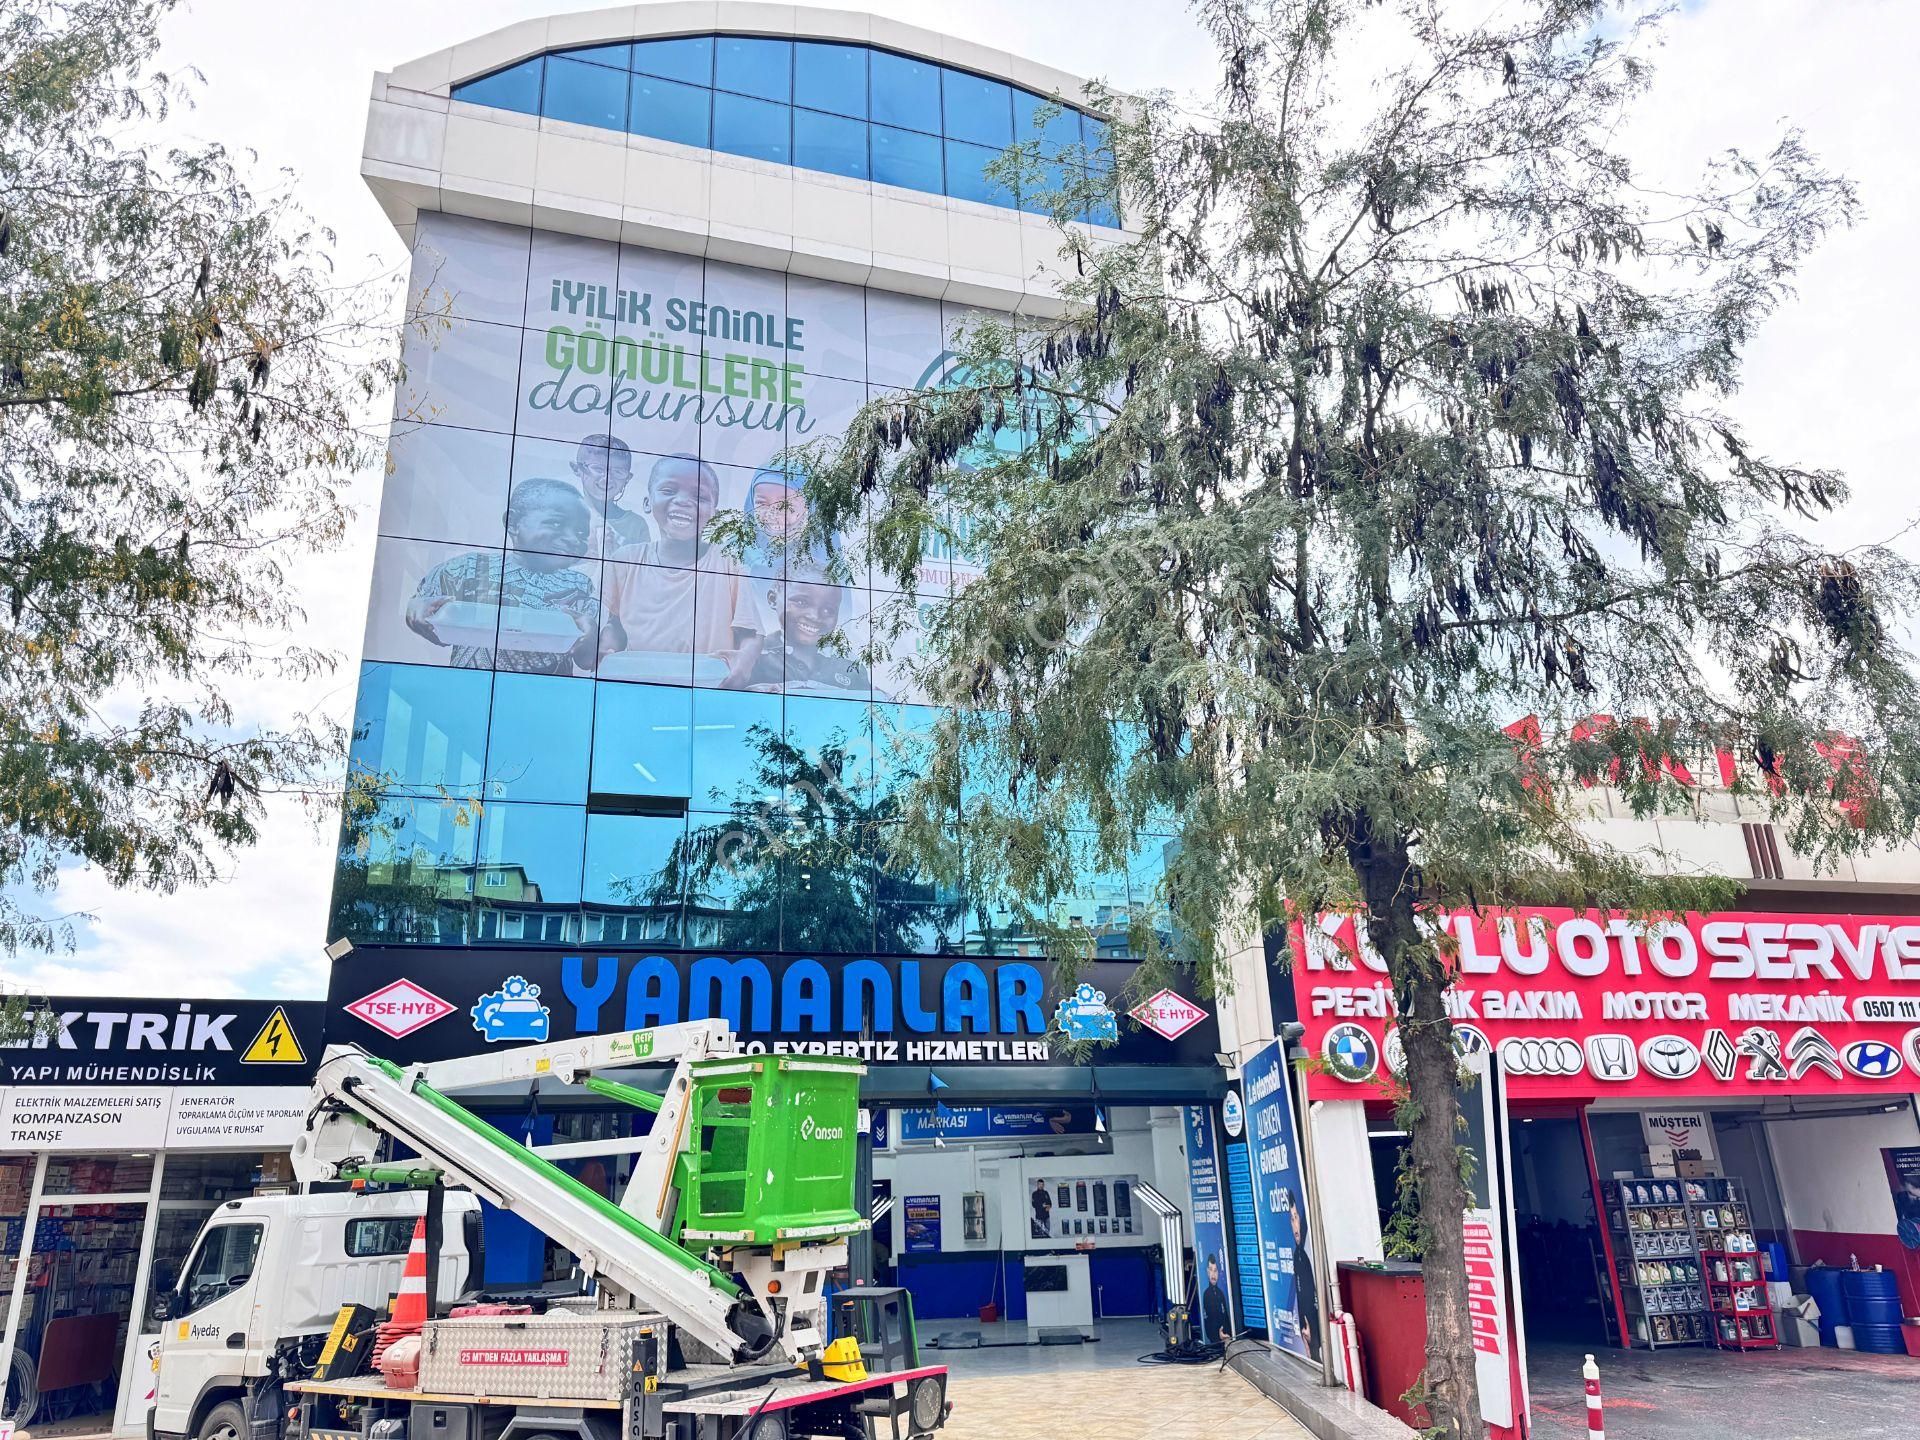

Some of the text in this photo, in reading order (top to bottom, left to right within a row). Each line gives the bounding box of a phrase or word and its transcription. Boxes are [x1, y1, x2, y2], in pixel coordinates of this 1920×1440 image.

[550, 279, 805, 351] İYİLİK SENİNLE
[545, 321, 805, 406] GÖNÜLLERE
[528, 364, 817, 434] dokunsun
[1556, 917, 1698, 978] OTO
[561, 956, 1047, 1034] YAMANLAR
[366, 1002, 436, 1015] TSE-HYB
[1482, 990, 1583, 1020] BAKIM
[1602, 991, 1710, 1021] MOTOR
[1728, 989, 1852, 1022] MEKANİK
[1863, 1000, 1895, 1018] 0507
[639, 1043, 649, 1055] 18
[11, 1063, 217, 1081] YAPI MÜHENDİSLİK
[15, 1095, 162, 1109] ELEKTRİK MALZEMELERİ SATIŞ
[180, 1095, 235, 1106] JENERATÖR
[12, 1112, 122, 1124] KOMPANZASON
[178, 1110, 227, 1120] TOPRAKLAMA
[228, 1108, 254, 1121] ÖLÇÜM
[256, 1110, 265, 1119] VE
[1648, 1114, 1702, 1130] MÜŞTERİ
[10, 1130, 63, 1143] TRANŞE
[176, 1124, 265, 1135] UYGULAMA VE RUHSAT
[815, 1126, 843, 1140] ansan
[1270, 1181, 1290, 1213] adres
[191, 1324, 221, 1340] Ayedaş
[461, 1352, 471, 1363] 25
[471, 1352, 499, 1363] MT'DEN
[500, 1352, 522, 1363] FAZLA
[523, 1351, 562, 1366] YAKLAŞMA
[632, 1381, 642, 1440] ansa
